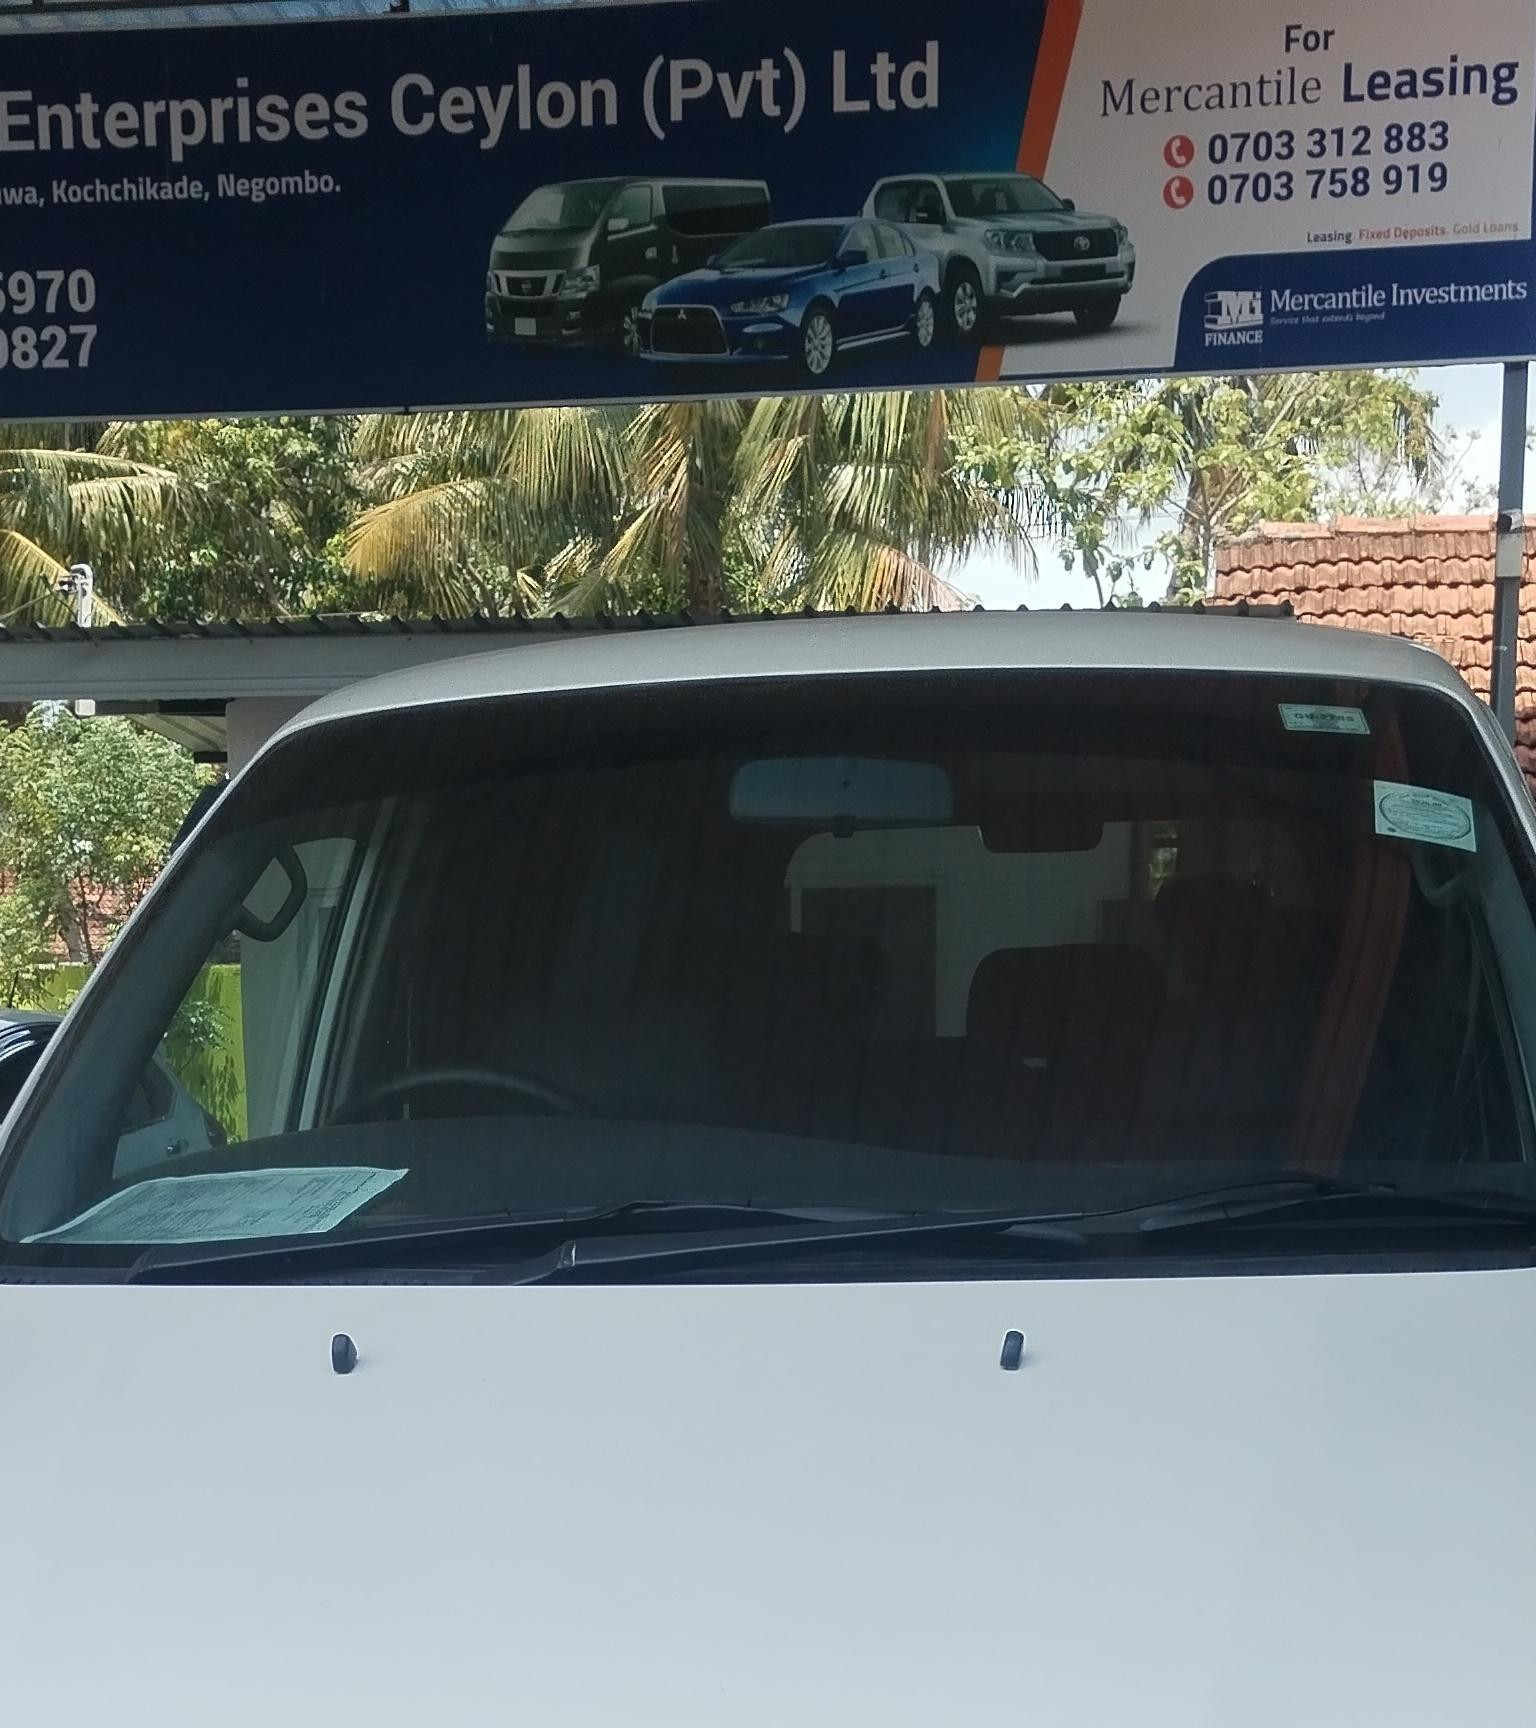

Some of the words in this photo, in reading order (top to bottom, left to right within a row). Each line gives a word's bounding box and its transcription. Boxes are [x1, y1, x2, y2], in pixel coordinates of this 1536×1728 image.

[1285, 24, 1336, 53] For
[390, 64, 618, 149] Ceylon
[643, 47, 805, 140] (Pvt)
[832, 41, 939, 113] Ltd
[1101, 66, 1322, 117] Mercantile
[1343, 55, 1520, 105] Leasing
[1208, 129, 1295, 165] 0703
[1307, 125, 1372, 159] 312
[1384, 120, 1450, 154] 883
[52, 175, 210, 203] Kochchikade,
[218, 169, 341, 202] Negombo.
[1207, 170, 1294, 206] 0703
[1306, 166, 1371, 200] 758
[1383, 161, 1448, 195] 919
[1307, 230, 1353, 244] Leasing
[1270, 283, 1386, 313] Mercantile
[1391, 279, 1527, 307] Investments
[1204, 331, 1263, 347] FINANCE
